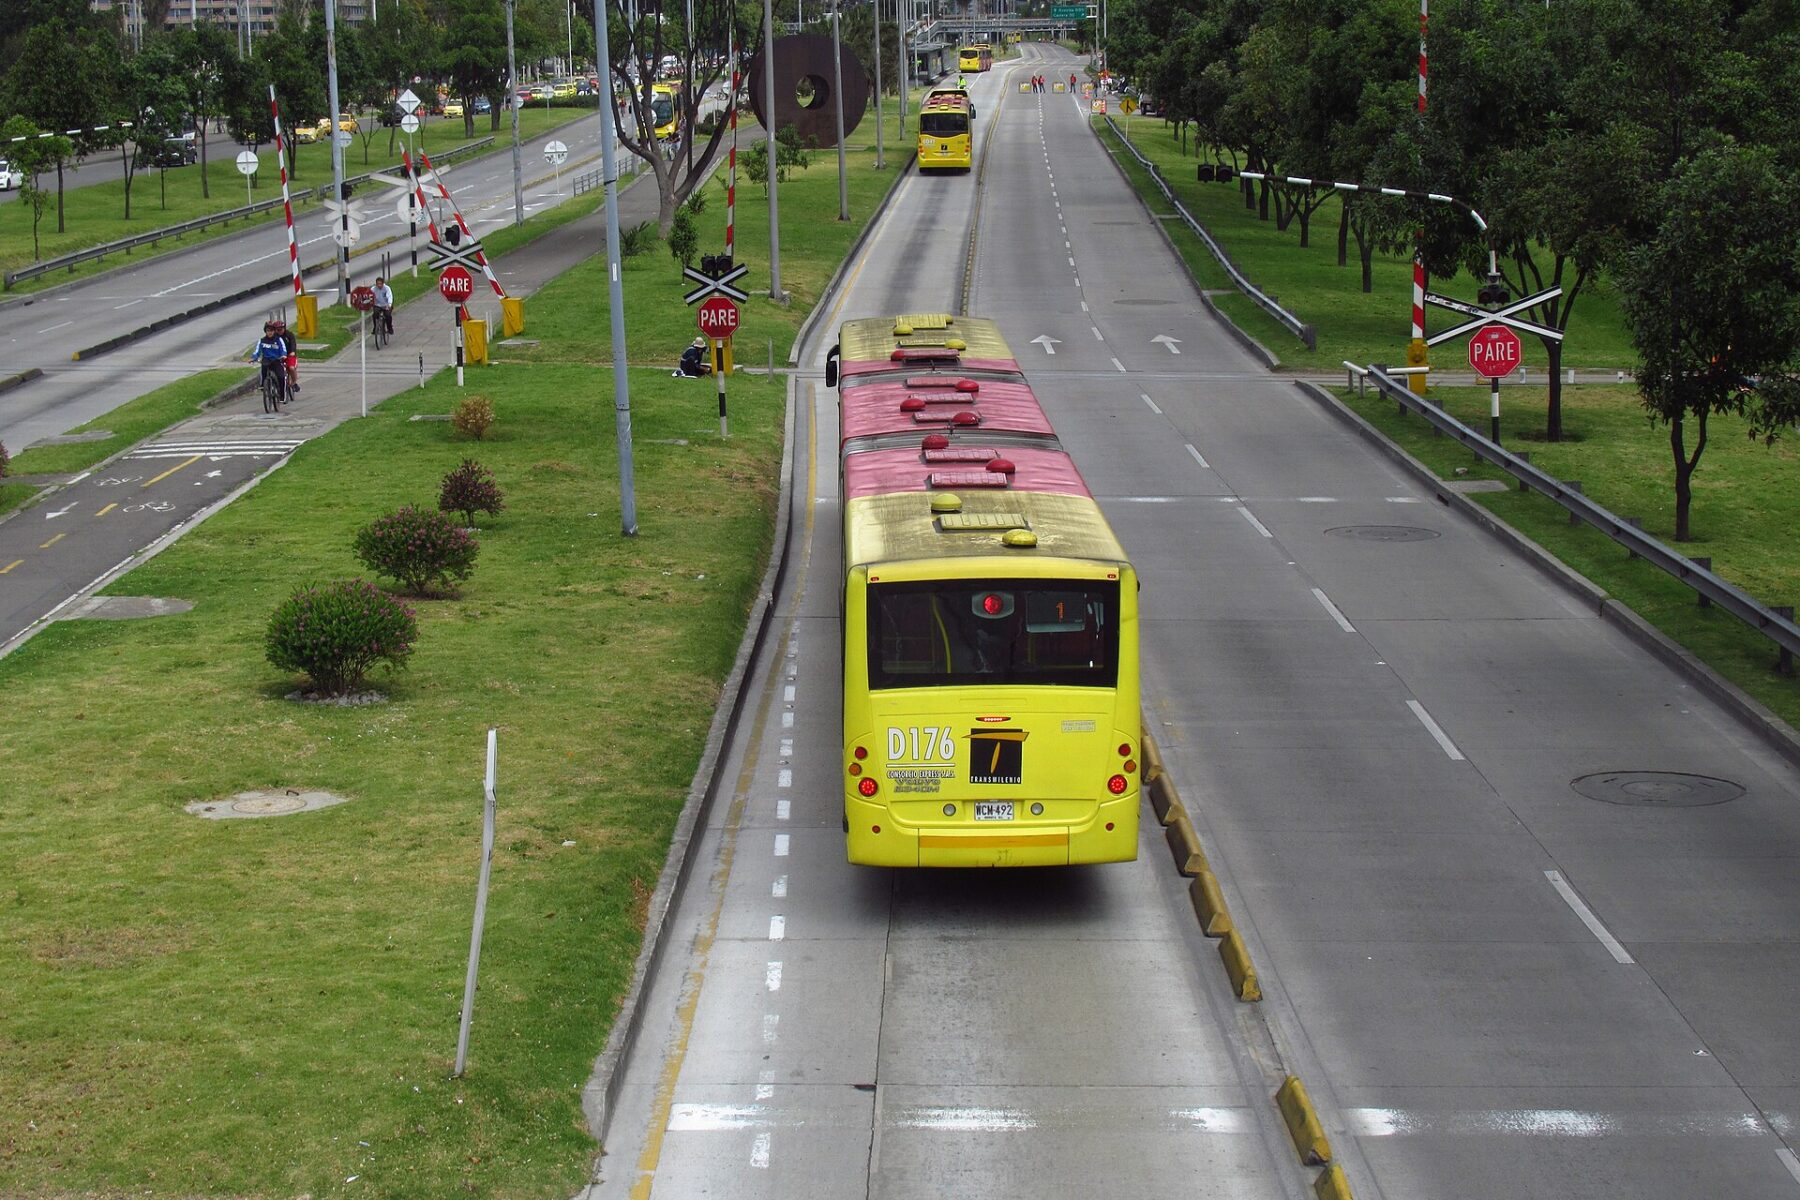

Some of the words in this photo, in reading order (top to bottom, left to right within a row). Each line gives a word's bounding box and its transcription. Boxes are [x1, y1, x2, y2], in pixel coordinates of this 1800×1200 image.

[442, 277, 470, 292] PARE
[700, 309, 736, 327] PARE
[1474, 341, 1516, 361] PARE
[887, 726, 956, 761] D176
[887, 770, 918, 779] CONSORCIO
[919, 770, 939, 778] EXPRESS
[970, 775, 1021, 784] TRANSMILENIO
[976, 804, 1013, 816] WCM-492
